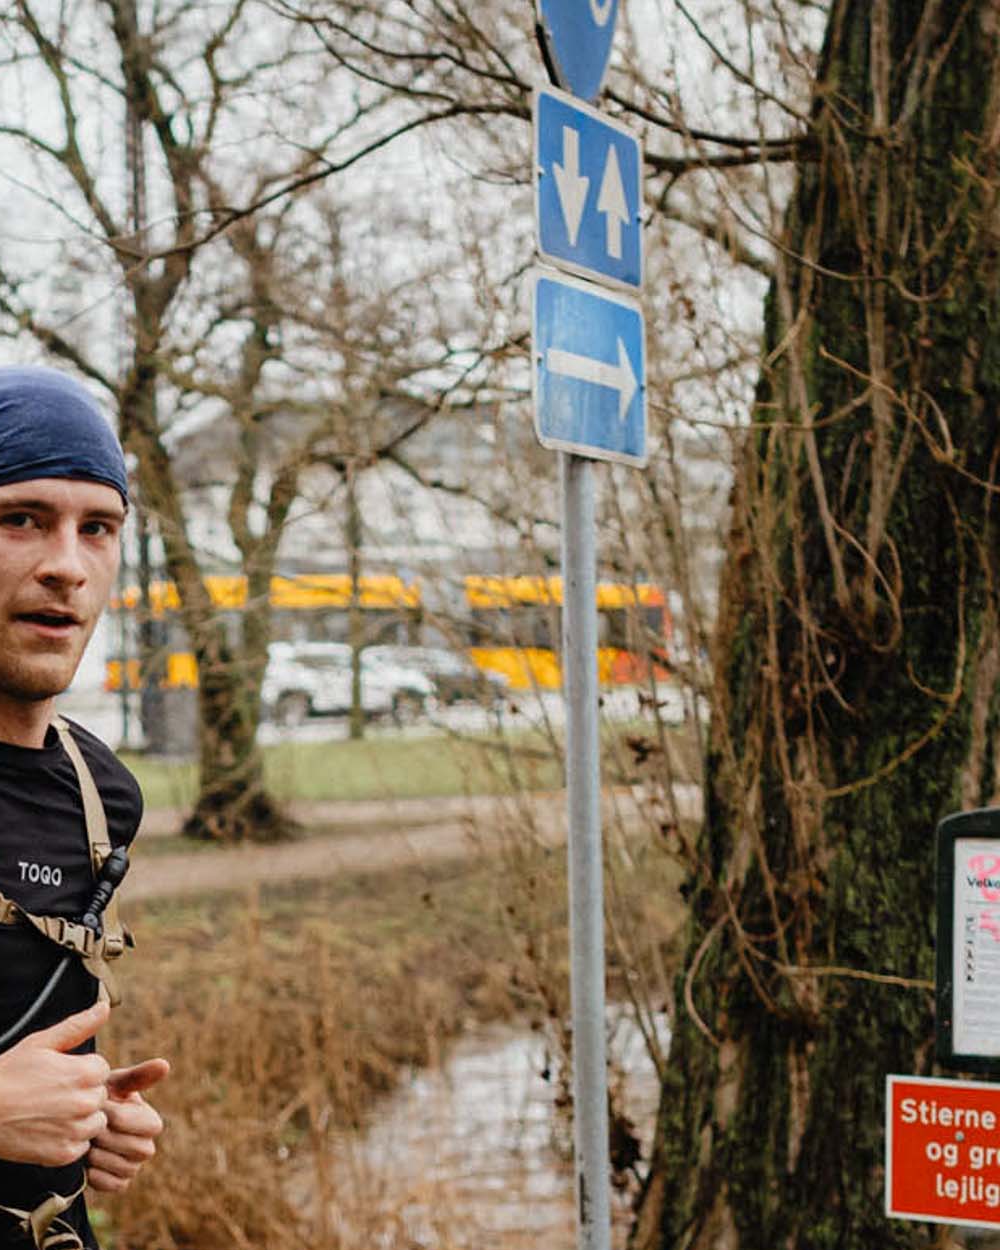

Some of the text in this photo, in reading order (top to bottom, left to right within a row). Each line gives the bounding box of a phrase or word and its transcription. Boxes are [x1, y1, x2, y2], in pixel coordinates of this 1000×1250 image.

[900, 1098, 996, 1130] Stierne
[926, 1141, 1000, 1169] og gr
[936, 1173, 1000, 1207] lejlig
